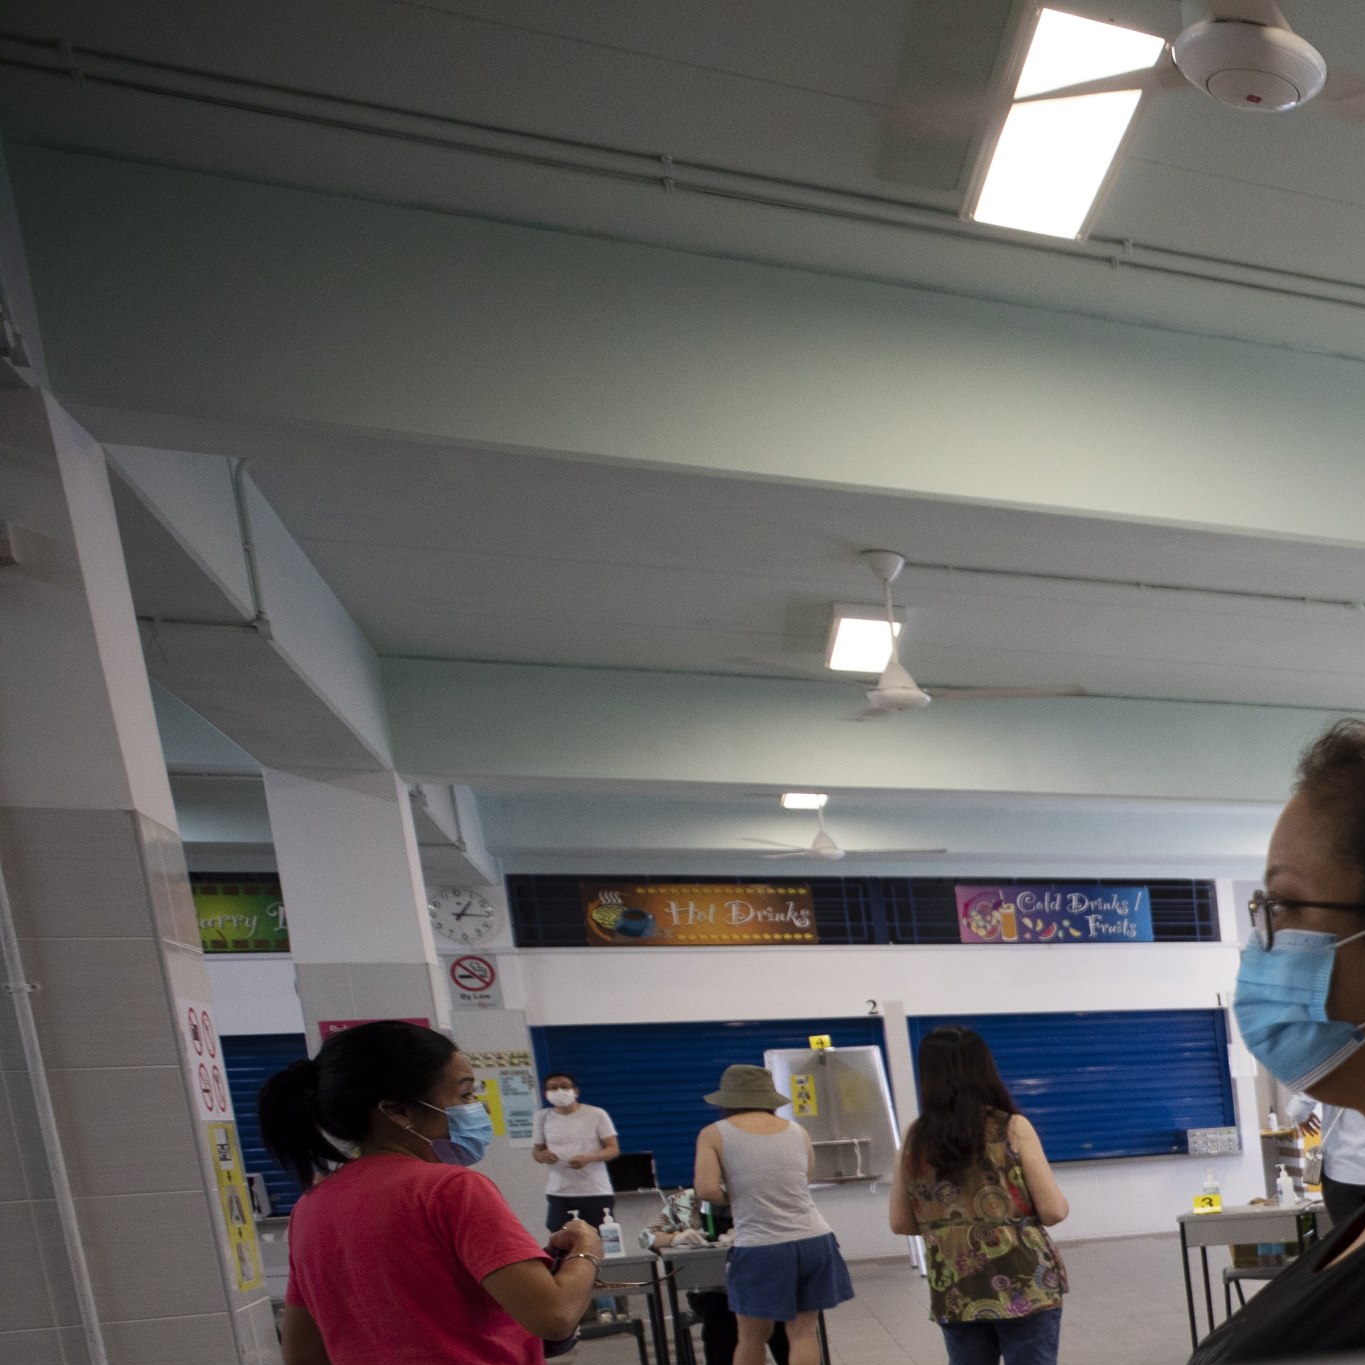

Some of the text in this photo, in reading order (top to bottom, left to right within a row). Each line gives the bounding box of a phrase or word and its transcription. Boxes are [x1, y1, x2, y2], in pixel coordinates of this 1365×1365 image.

[664, 900, 811, 928] Hot Drinks
[1016, 890, 1061, 912] Cold
[1067, 891, 1129, 915] Drinks
[1085, 914, 1137, 938] Fruits
[865, 999, 879, 1015] 2
[1201, 1196, 1213, 1208] 3
